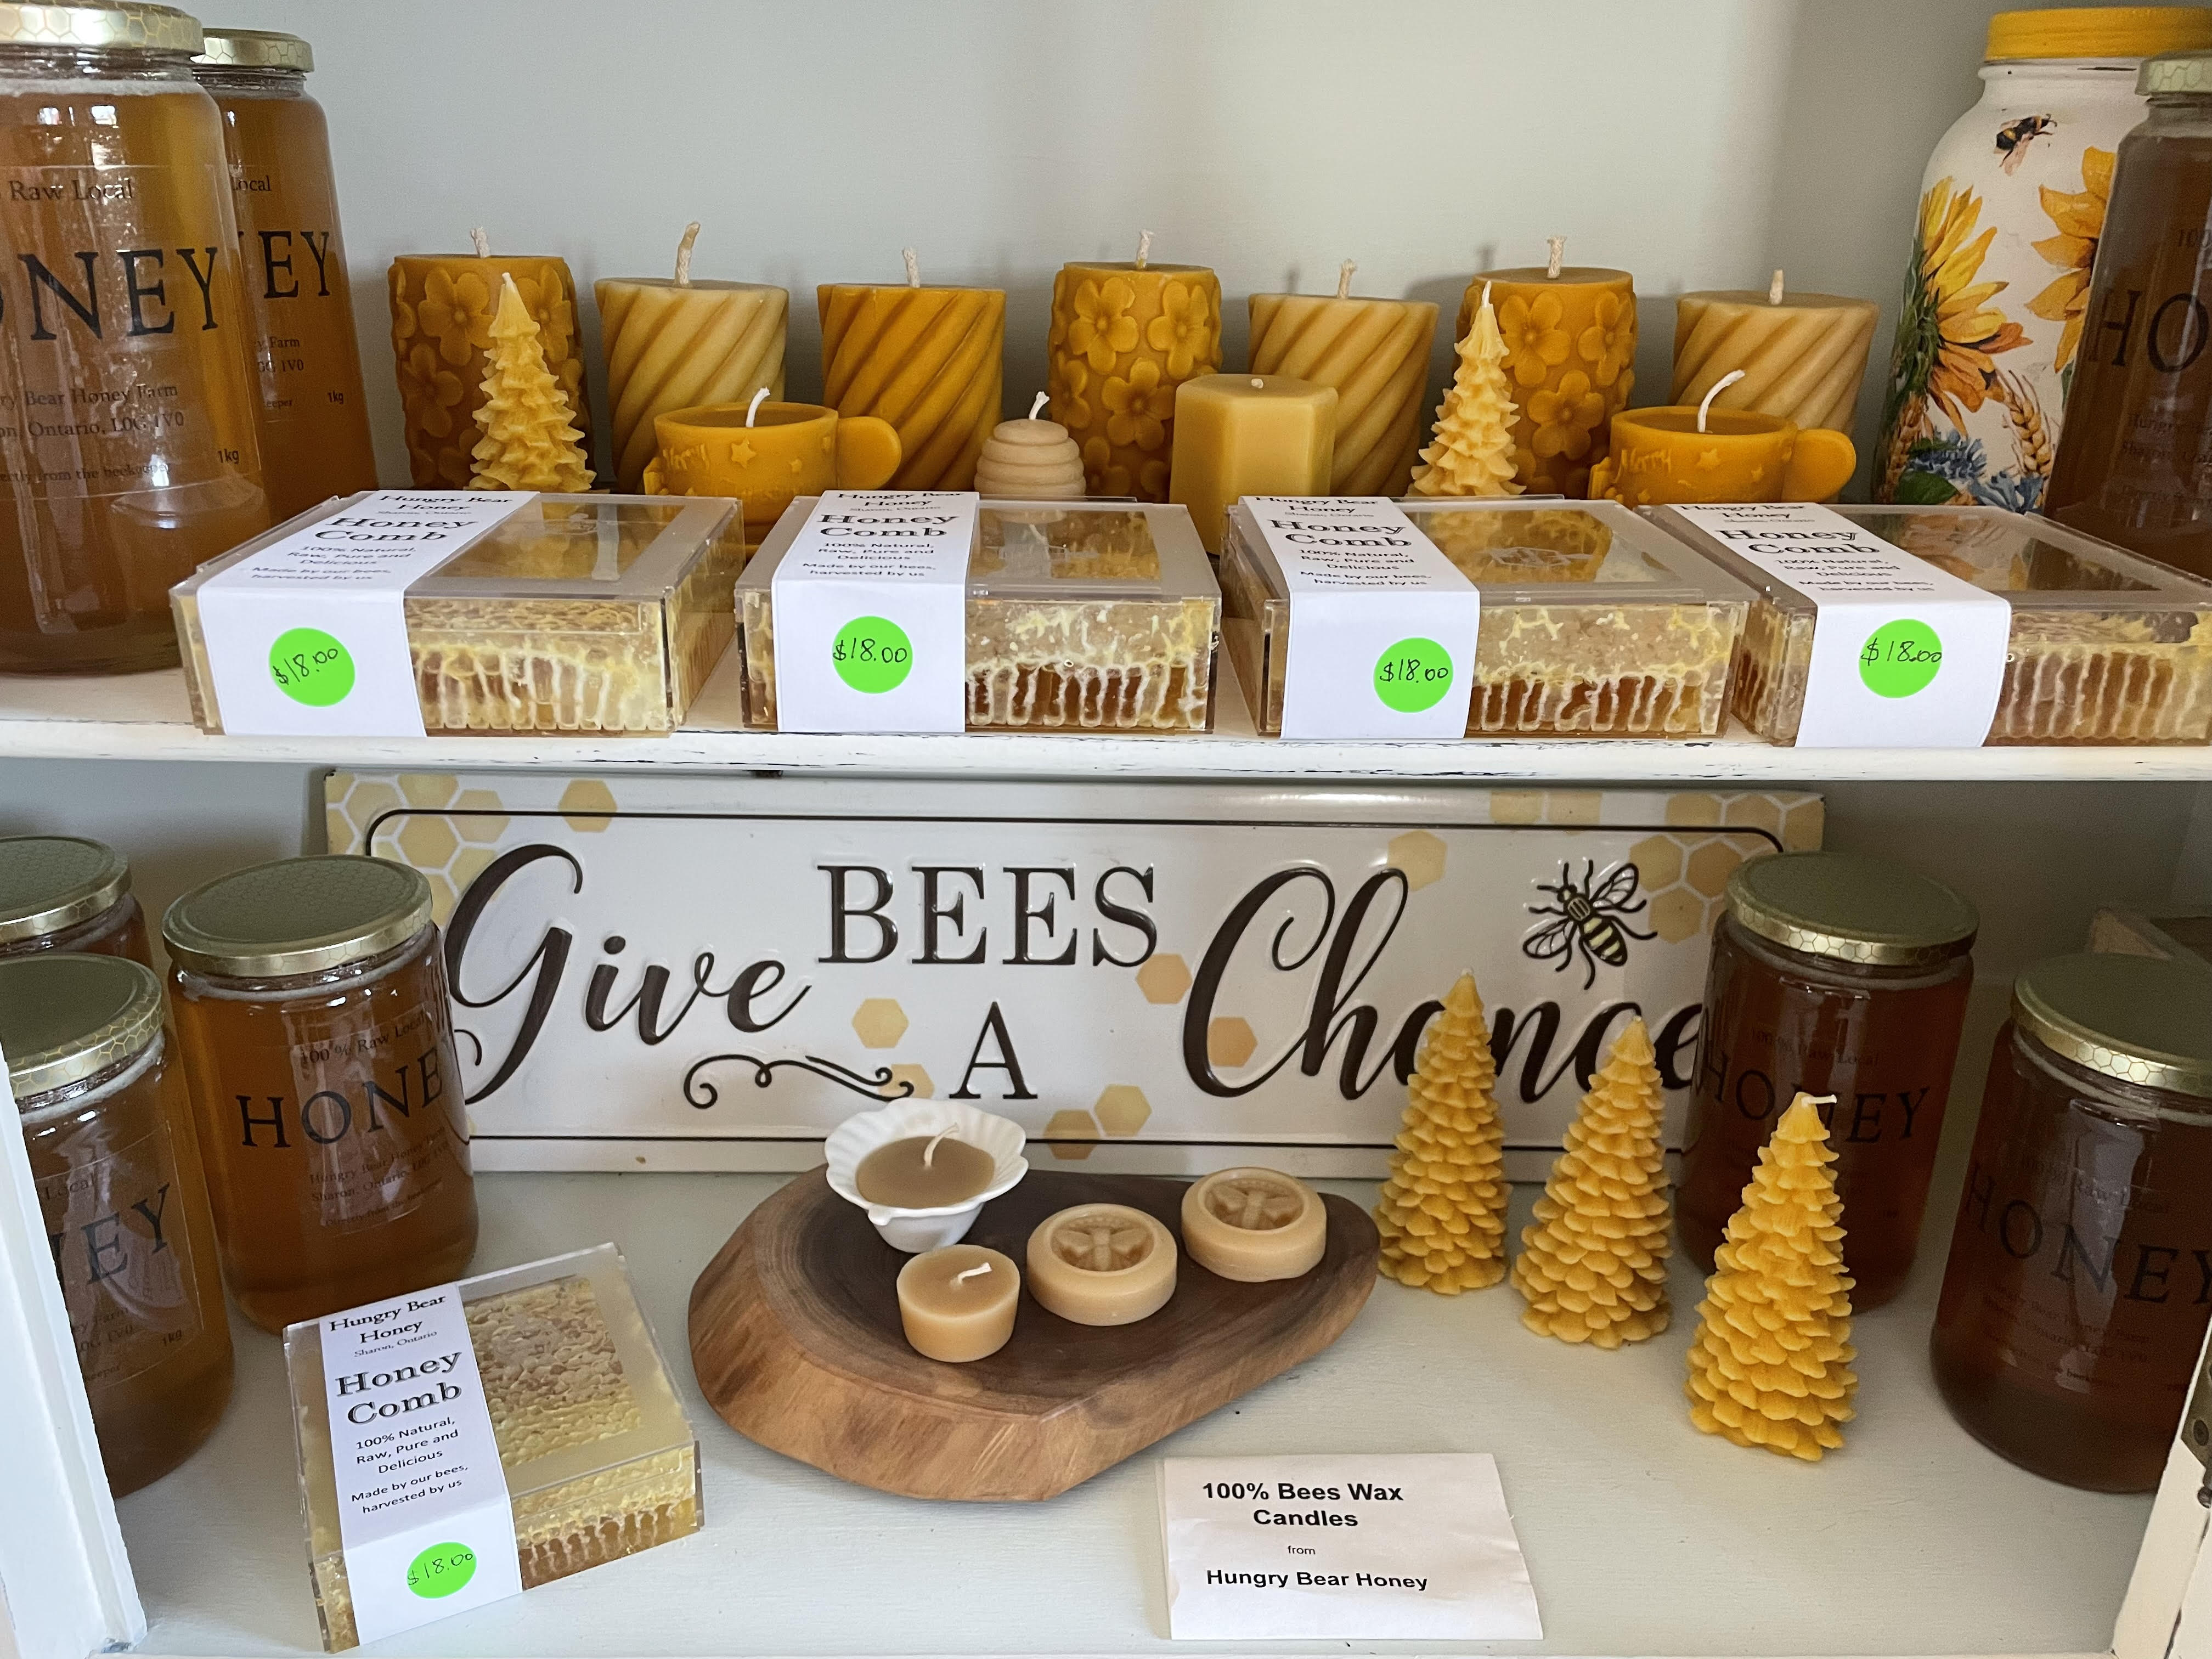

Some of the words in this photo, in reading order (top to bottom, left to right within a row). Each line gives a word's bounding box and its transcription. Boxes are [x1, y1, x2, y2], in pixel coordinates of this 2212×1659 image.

[9, 180, 62, 201] Raw
[74, 178, 133, 201] Local
[0, 247, 218, 341] NEY
[2088, 288, 2211, 374] HO
[25, 390, 65, 406] Bear
[72, 387, 132, 406] Honey
[137, 385, 178, 399] Farm
[327, 391, 344, 405] 1kg
[29, 420, 106, 437] Ontario,
[218, 448, 240, 464] 1kg
[1255, 496, 1330, 505] Hungry
[1289, 505, 1356, 514] Honey
[326, 517, 479, 529] Honey
[817, 515, 960, 524] Honey
[1267, 520, 1406, 534] Honey
[315, 530, 448, 541] Comb
[820, 527, 947, 537] Comb
[1285, 534, 1412, 546] Comb
[1714, 529, 1858, 540] Honey
[1748, 543, 1880, 554] Comb
[832, 637, 907, 663] $18.00
[1860, 637, 1944, 666] $18.00
[272, 648, 339, 686] $18.00
[1379, 658, 1449, 684] $18.00
[817, 865, 1158, 967] BEES
[444, 844, 812, 1106] Give
[357, 1031, 391, 1053] Raw
[949, 1000, 1039, 1100] A
[235, 1047, 443, 1149] HONE
[1702, 1051, 1931, 1144] HOEY
[330, 1308, 402, 1331] Hungry
[407, 1295, 447, 1313] Bear
[359, 1321, 423, 1344] Honey
[354, 1343, 394, 1358] Sharon,
[397, 1331, 438, 1346] Ontario
[334, 1351, 463, 1398] Honey
[347, 1381, 462, 1425] Comb
[356, 1431, 394, 1450] 100%
[399, 1416, 456, 1440] Natural,
[356, 1449, 392, 1464] Raw,
[396, 1438, 429, 1455] Pure
[433, 1429, 459, 1444] and
[379, 1450, 443, 1474] Delicious
[351, 1485, 389, 1502] Made
[392, 1479, 408, 1492] by
[410, 1474, 432, 1486] our
[435, 1465, 469, 1480] bees,
[1203, 1482, 1269, 1500] 100%
[1278, 1482, 1340, 1500] Bees
[1347, 1483, 1404, 1501] Wax
[362, 1489, 426, 1514] harvested
[429, 1483, 445, 1497] by
[448, 1480, 462, 1489] us
[1253, 1509, 1359, 1527] Candles
[1288, 1545, 1316, 1555] from
[407, 1553, 473, 1586] $18.00
[1206, 1570, 1289, 1588] Hungry
[1296, 1571, 1350, 1587] Bear
[1356, 1572, 1428, 1592] Honey
